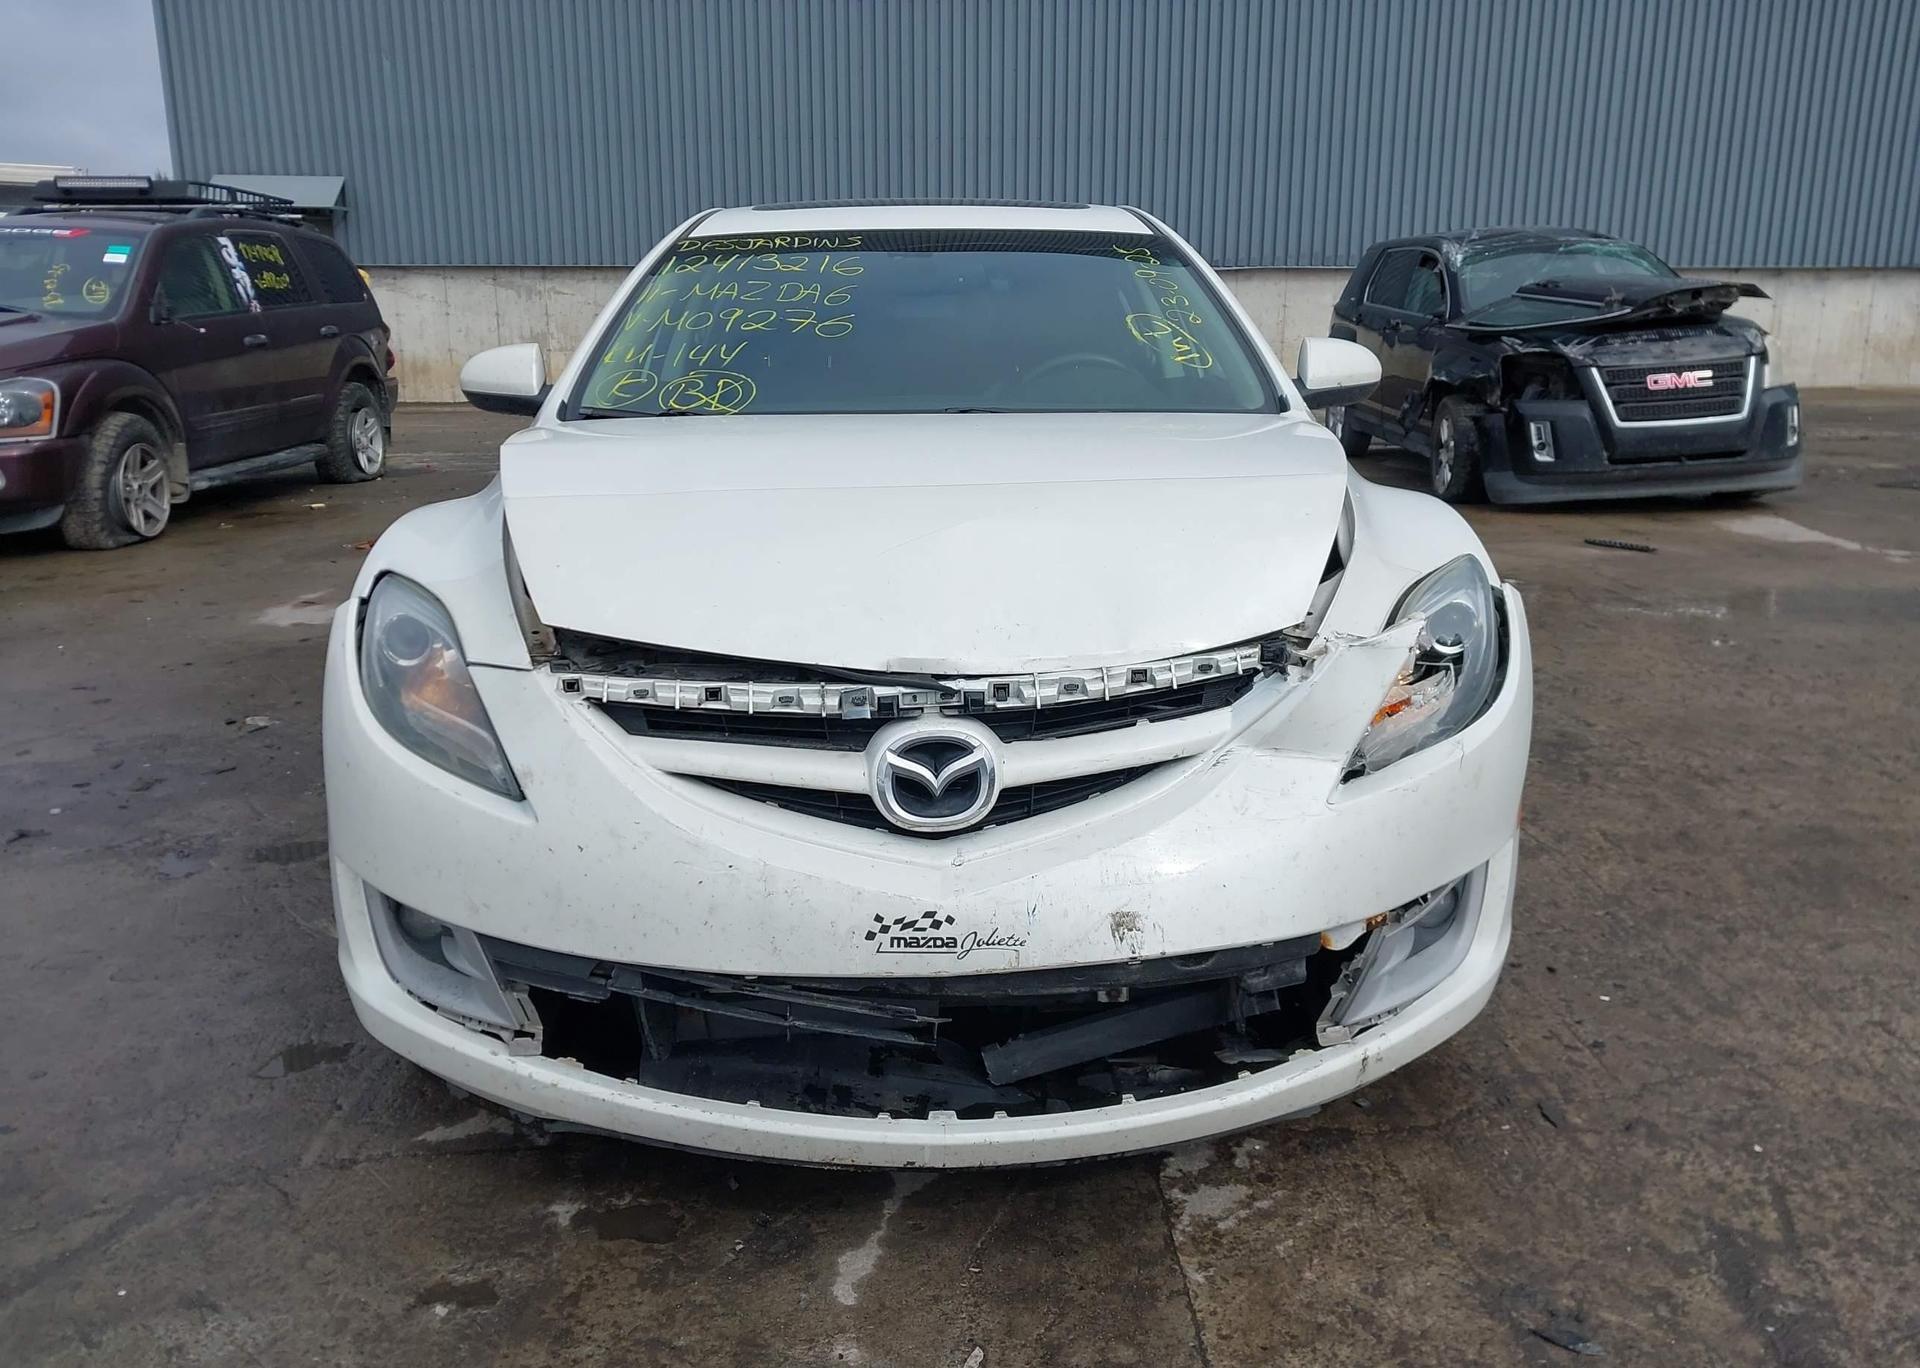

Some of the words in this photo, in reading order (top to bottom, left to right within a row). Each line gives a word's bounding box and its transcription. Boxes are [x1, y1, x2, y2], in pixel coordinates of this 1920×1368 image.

[678, 236, 864, 251] DESJARDINS
[662, 253, 864, 276] 12413216
[1646, 369, 1714, 391] GMC
[889, 936, 958, 949] mazda
[956, 927, 1027, 960] Joliette
